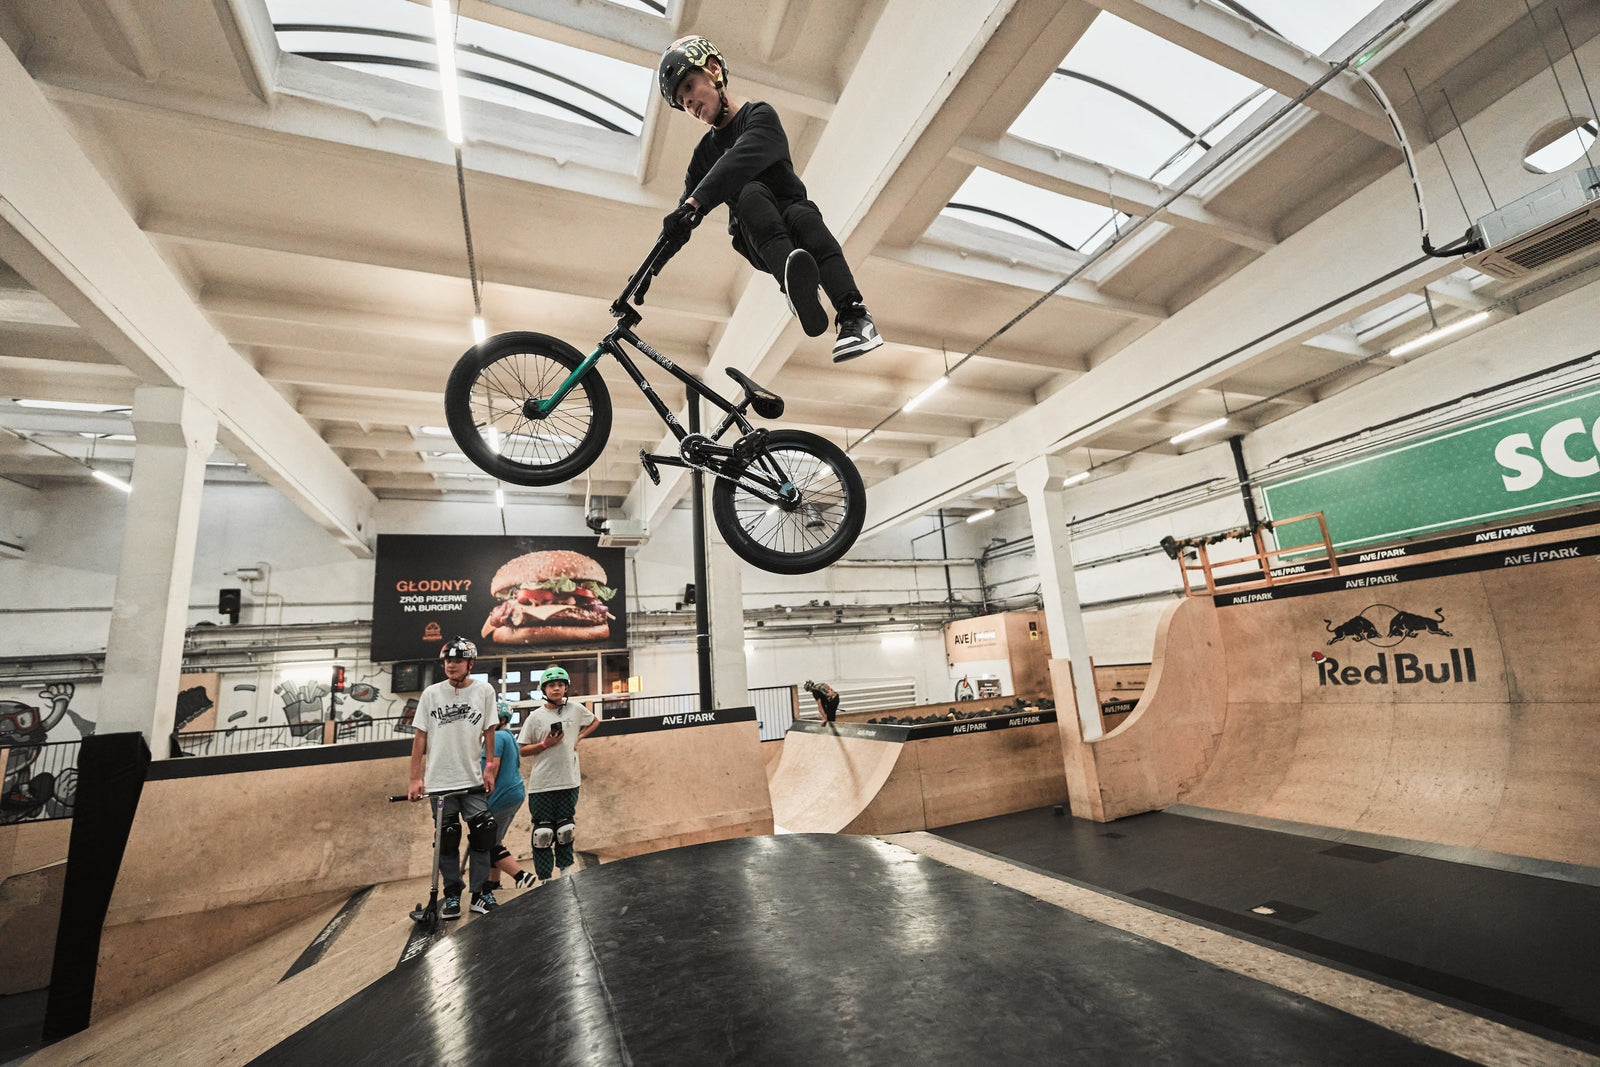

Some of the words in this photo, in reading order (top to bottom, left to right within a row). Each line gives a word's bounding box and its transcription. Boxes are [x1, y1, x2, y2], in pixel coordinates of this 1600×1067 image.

[1475, 524, 1536, 542] AVE/PARK
[1359, 547, 1406, 563] AVE/PARK
[1504, 546, 1580, 566] AVE/PARK
[396, 579, 472, 592] GŁODNY?
[1345, 574, 1399, 588] AVE/PARK
[399, 595, 425, 604] ZRÓB
[426, 594, 467, 603] PRZERWĘ
[1233, 592, 1273, 604] AVE/PARK
[418, 603, 463, 611] BURGERA!
[1318, 652, 1388, 686] Red
[1394, 648, 1477, 684] Bull
[662, 712, 715, 725] AVE/PARK
[1008, 715, 1041, 727] AVE/PARK
[953, 722, 988, 734] AVE/PARK
